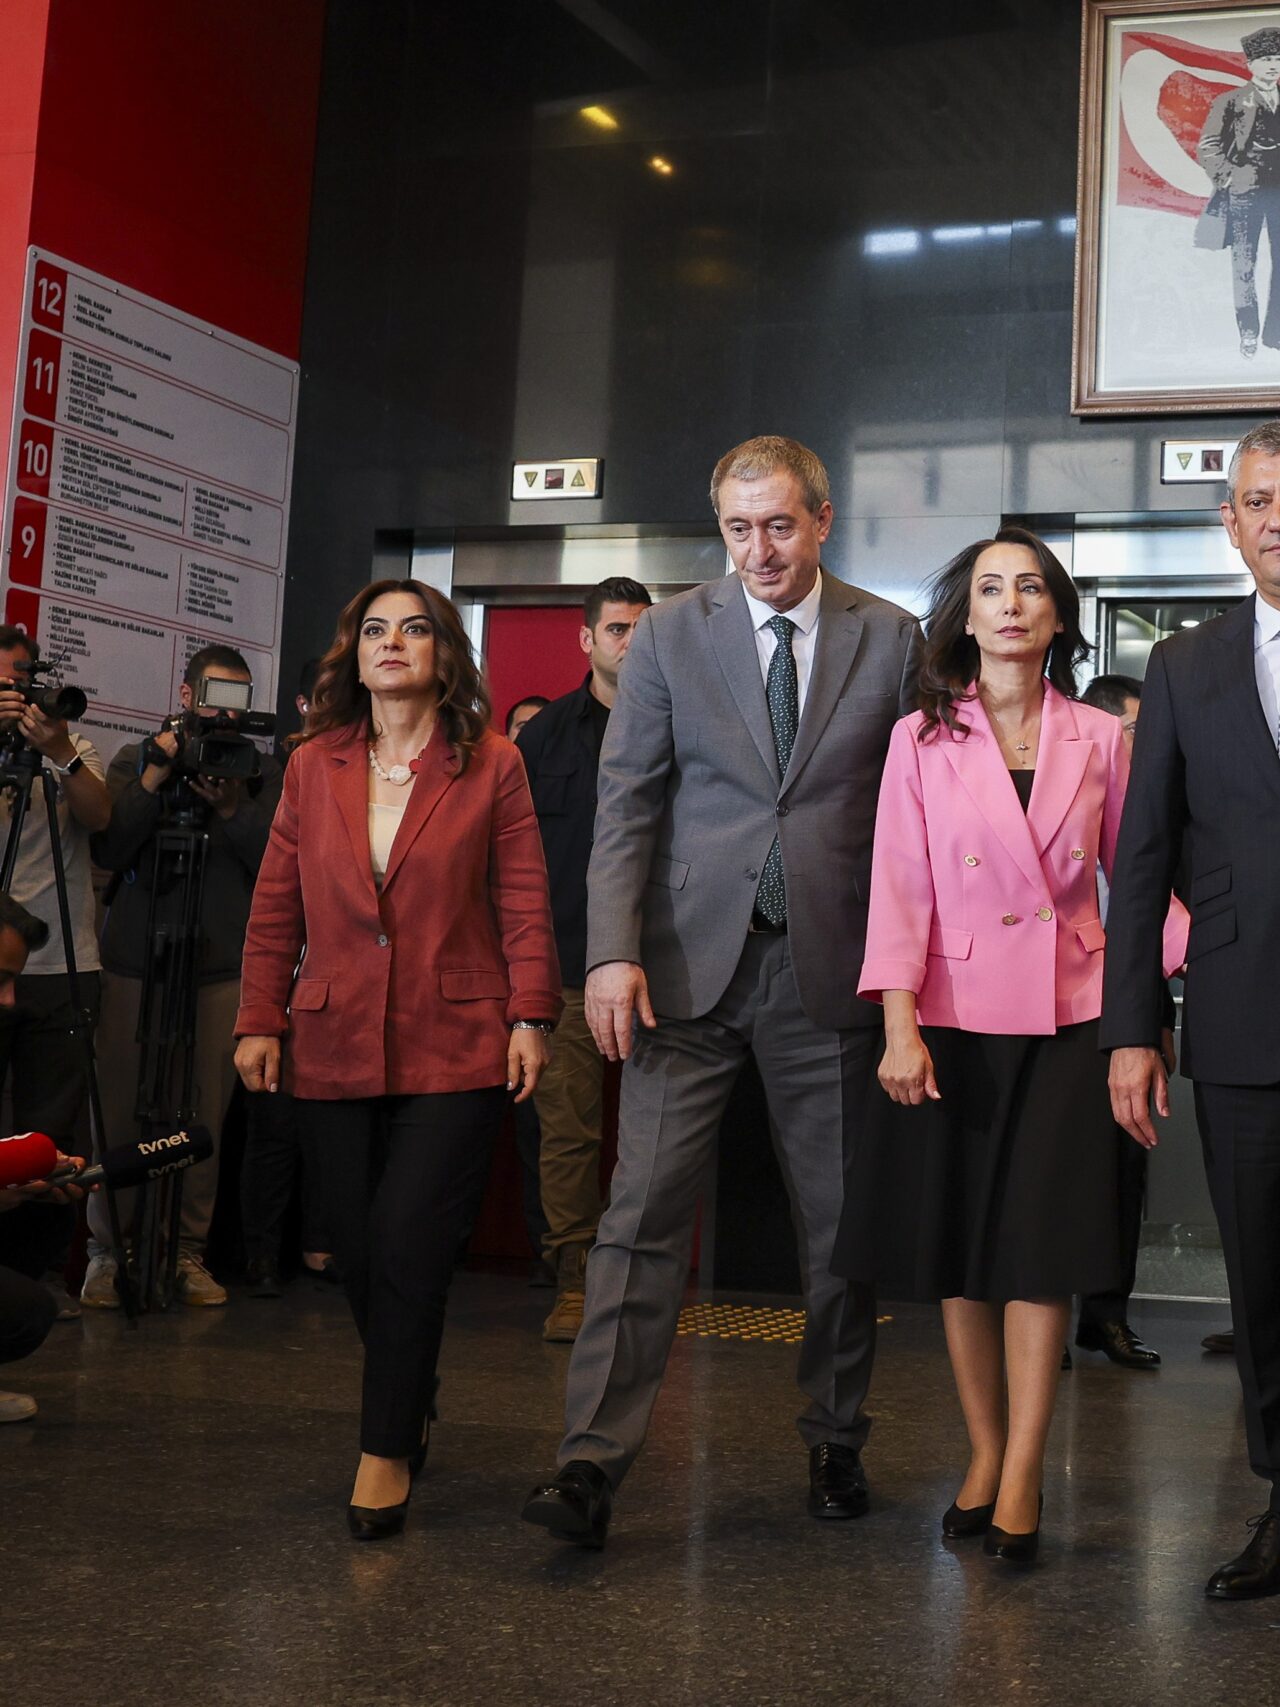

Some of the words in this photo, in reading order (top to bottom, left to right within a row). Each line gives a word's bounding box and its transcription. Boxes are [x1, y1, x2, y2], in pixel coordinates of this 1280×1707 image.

[38, 277, 62, 316] 12
[33, 357, 55, 394] 11
[24, 440, 48, 476] 10
[22, 525, 36, 559] 9
[138, 1131, 189, 1154] tvnet
[149, 1155, 194, 1177] tvnet
